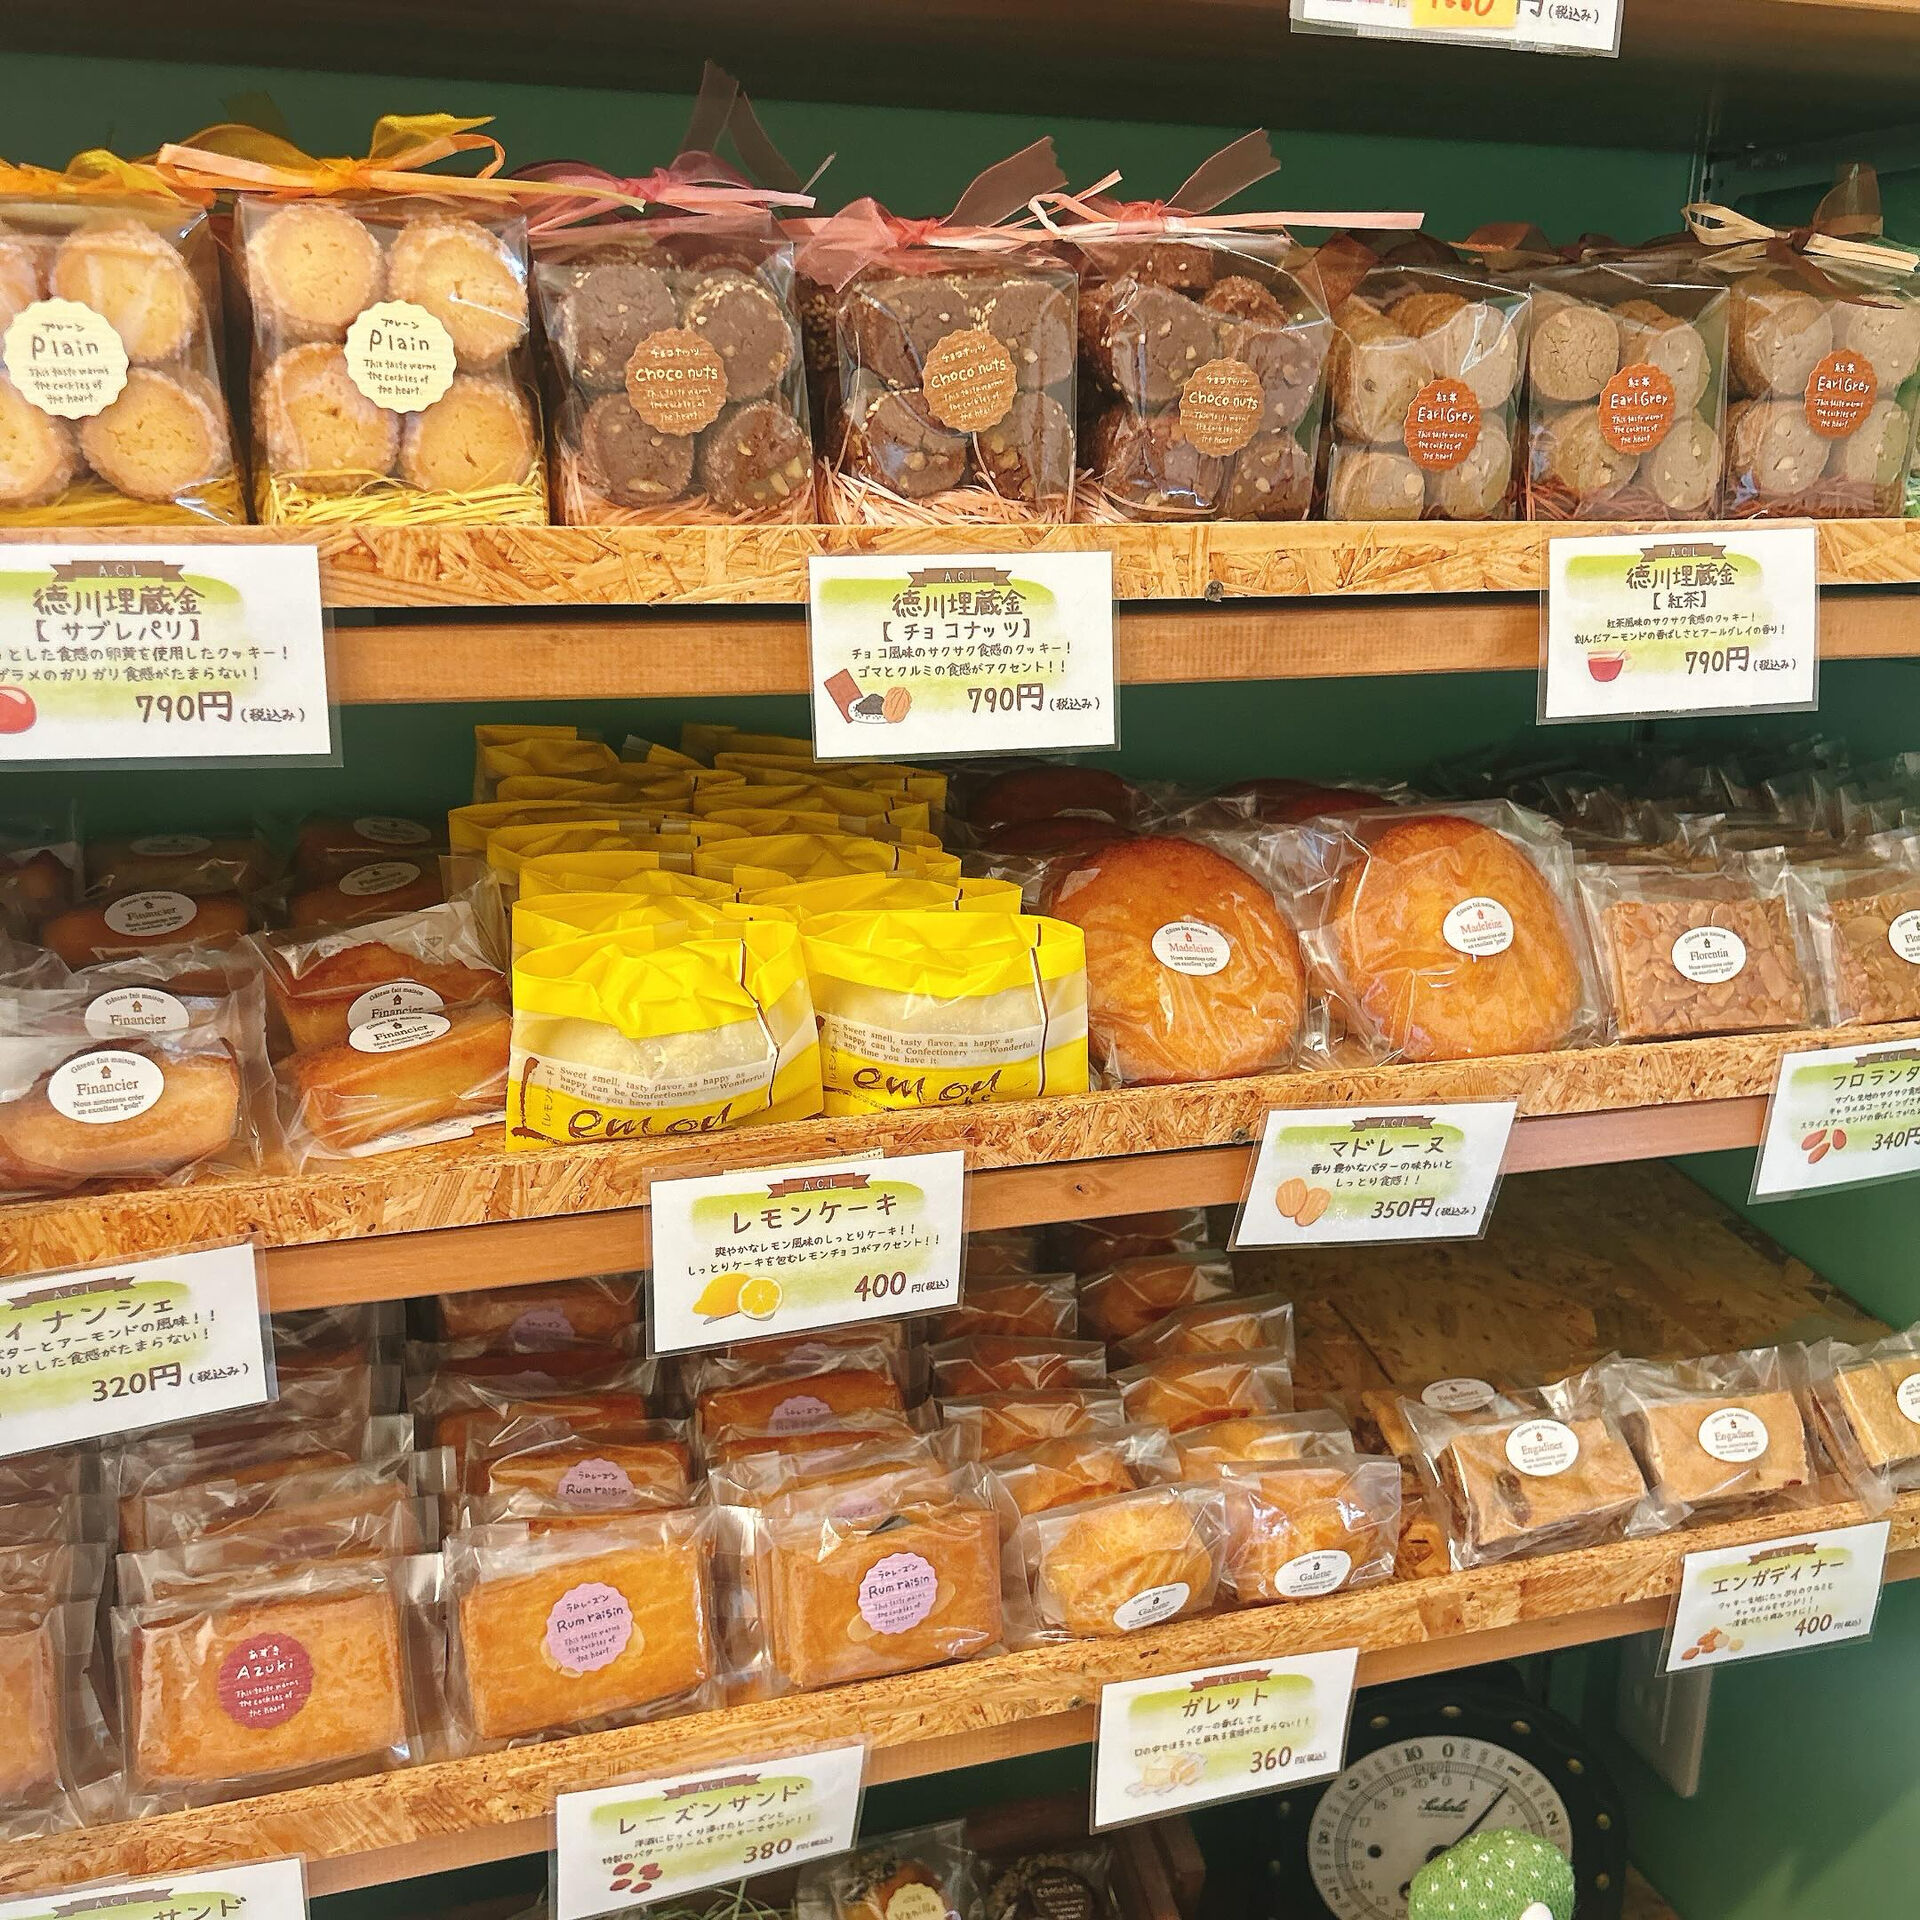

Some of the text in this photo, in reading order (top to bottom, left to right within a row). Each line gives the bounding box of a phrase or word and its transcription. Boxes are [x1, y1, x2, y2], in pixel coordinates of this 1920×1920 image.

[1549, 4, 1599, 24] (税込み)
[381, 318, 419, 329] プレーン
[32, 336, 98, 360] Plain
[370, 329, 429, 352] Plain
[635, 365, 718, 381] Choco nuts
[931, 358, 1006, 388] Choco nuts
[1817, 376, 1870, 393] Earl Grey
[1189, 391, 1258, 410] Choco nuts
[1610, 392, 1668, 408] Earl Grey
[1418, 406, 1474, 424] Earl Grey
[1669, 547, 1697, 557] A.C.L
[100, 564, 141, 577] A.C.L
[944, 571, 978, 583] A.C.L
[1626, 562, 1738, 590] 徳川埋蔵金
[32, 584, 205, 617] 徳川埋蔵金
[892, 588, 1026, 619] 徳川埋蔵金
[1653, 590, 1706, 610] 【紅茶】
[34, 619, 201, 642] 【サブレパリ】
[883, 618, 1030, 642] 【チョコナッツ】
[1607, 613, 1755, 628] 紅茶風味のサクサク食感のクッキー！
[0, 646, 288, 662] とした食感の卵黄を使用したクッキー！
[852, 642, 1071, 660] チョコ風味のサクサク食感のクッキー！
[1686, 646, 1797, 674] 790円 (税込み)
[858, 661, 1065, 679] ゴマとクルミの食感がアクセント！！
[136, 691, 305, 724] 790円 (税込み)
[968, 683, 1100, 713] 790円 (税込み)
[1690, 948, 1729, 960] Florentin
[110, 1014, 166, 1025] Financier
[374, 1024, 428, 1041] Financier
[842, 1024, 866, 1036] Sweet
[870, 1032, 895, 1044] smell,
[900, 1039, 922, 1047] tasty
[974, 1039, 1000, 1047] happy
[844, 1032, 866, 1046] happy
[906, 1048, 967, 1056] Confectionery
[844, 1042, 857, 1051] any
[861, 1048, 880, 1057] time
[884, 1054, 899, 1062] you
[76, 1079, 138, 1096] Financier
[560, 1066, 587, 1079] Sweet
[592, 1074, 620, 1087] smell,
[626, 1081, 649, 1092] tasty
[654, 1084, 685, 1092] flavor,
[703, 1074, 730, 1085] happy
[560, 1075, 586, 1089] happy
[592, 1085, 608, 1093] can
[1833, 1066, 1920, 1090] フロランタ
[560, 1083, 575, 1094] any
[581, 1090, 600, 1100] time
[606, 1096, 623, 1105] you
[1380, 1118, 1406, 1128] A.C.L
[1329, 1137, 1444, 1158] マドレーヌ
[1872, 1127, 1920, 1150] 340円
[1311, 1160, 1453, 1175] 香り豊かなバターの味わいと
[802, 1178, 837, 1191] A.C.L
[1336, 1175, 1420, 1188] しっとり食感！！
[733, 1193, 897, 1234] レモンケーキ
[1370, 1196, 1435, 1220] 350円
[715, 1224, 916, 1258] 爽やかなレモン風味のしっとりケーキ！！
[688, 1235, 940, 1276] しっとりケーキを包むレモンチョコがアクセント！！
[854, 1271, 906, 1302] 400
[92, 1362, 249, 1402] 320円 (税込み)
[566, 1484, 591, 1494] Rum
[878, 1564, 918, 1578] ラムレーズン
[1712, 1559, 1844, 1594] エンガディナー
[868, 1576, 929, 1599] Rum raisin
[566, 1594, 609, 1613] ラムレーズン
[556, 1607, 624, 1633] Rum raisin
[1795, 1614, 1832, 1636] 400
[236, 1659, 293, 1679] Azuki
[1182, 1687, 1268, 1717] ガレット
[1250, 1746, 1291, 1773] 360
[619, 1783, 805, 1834] レーズンサンド
[744, 1838, 792, 1863] 380
